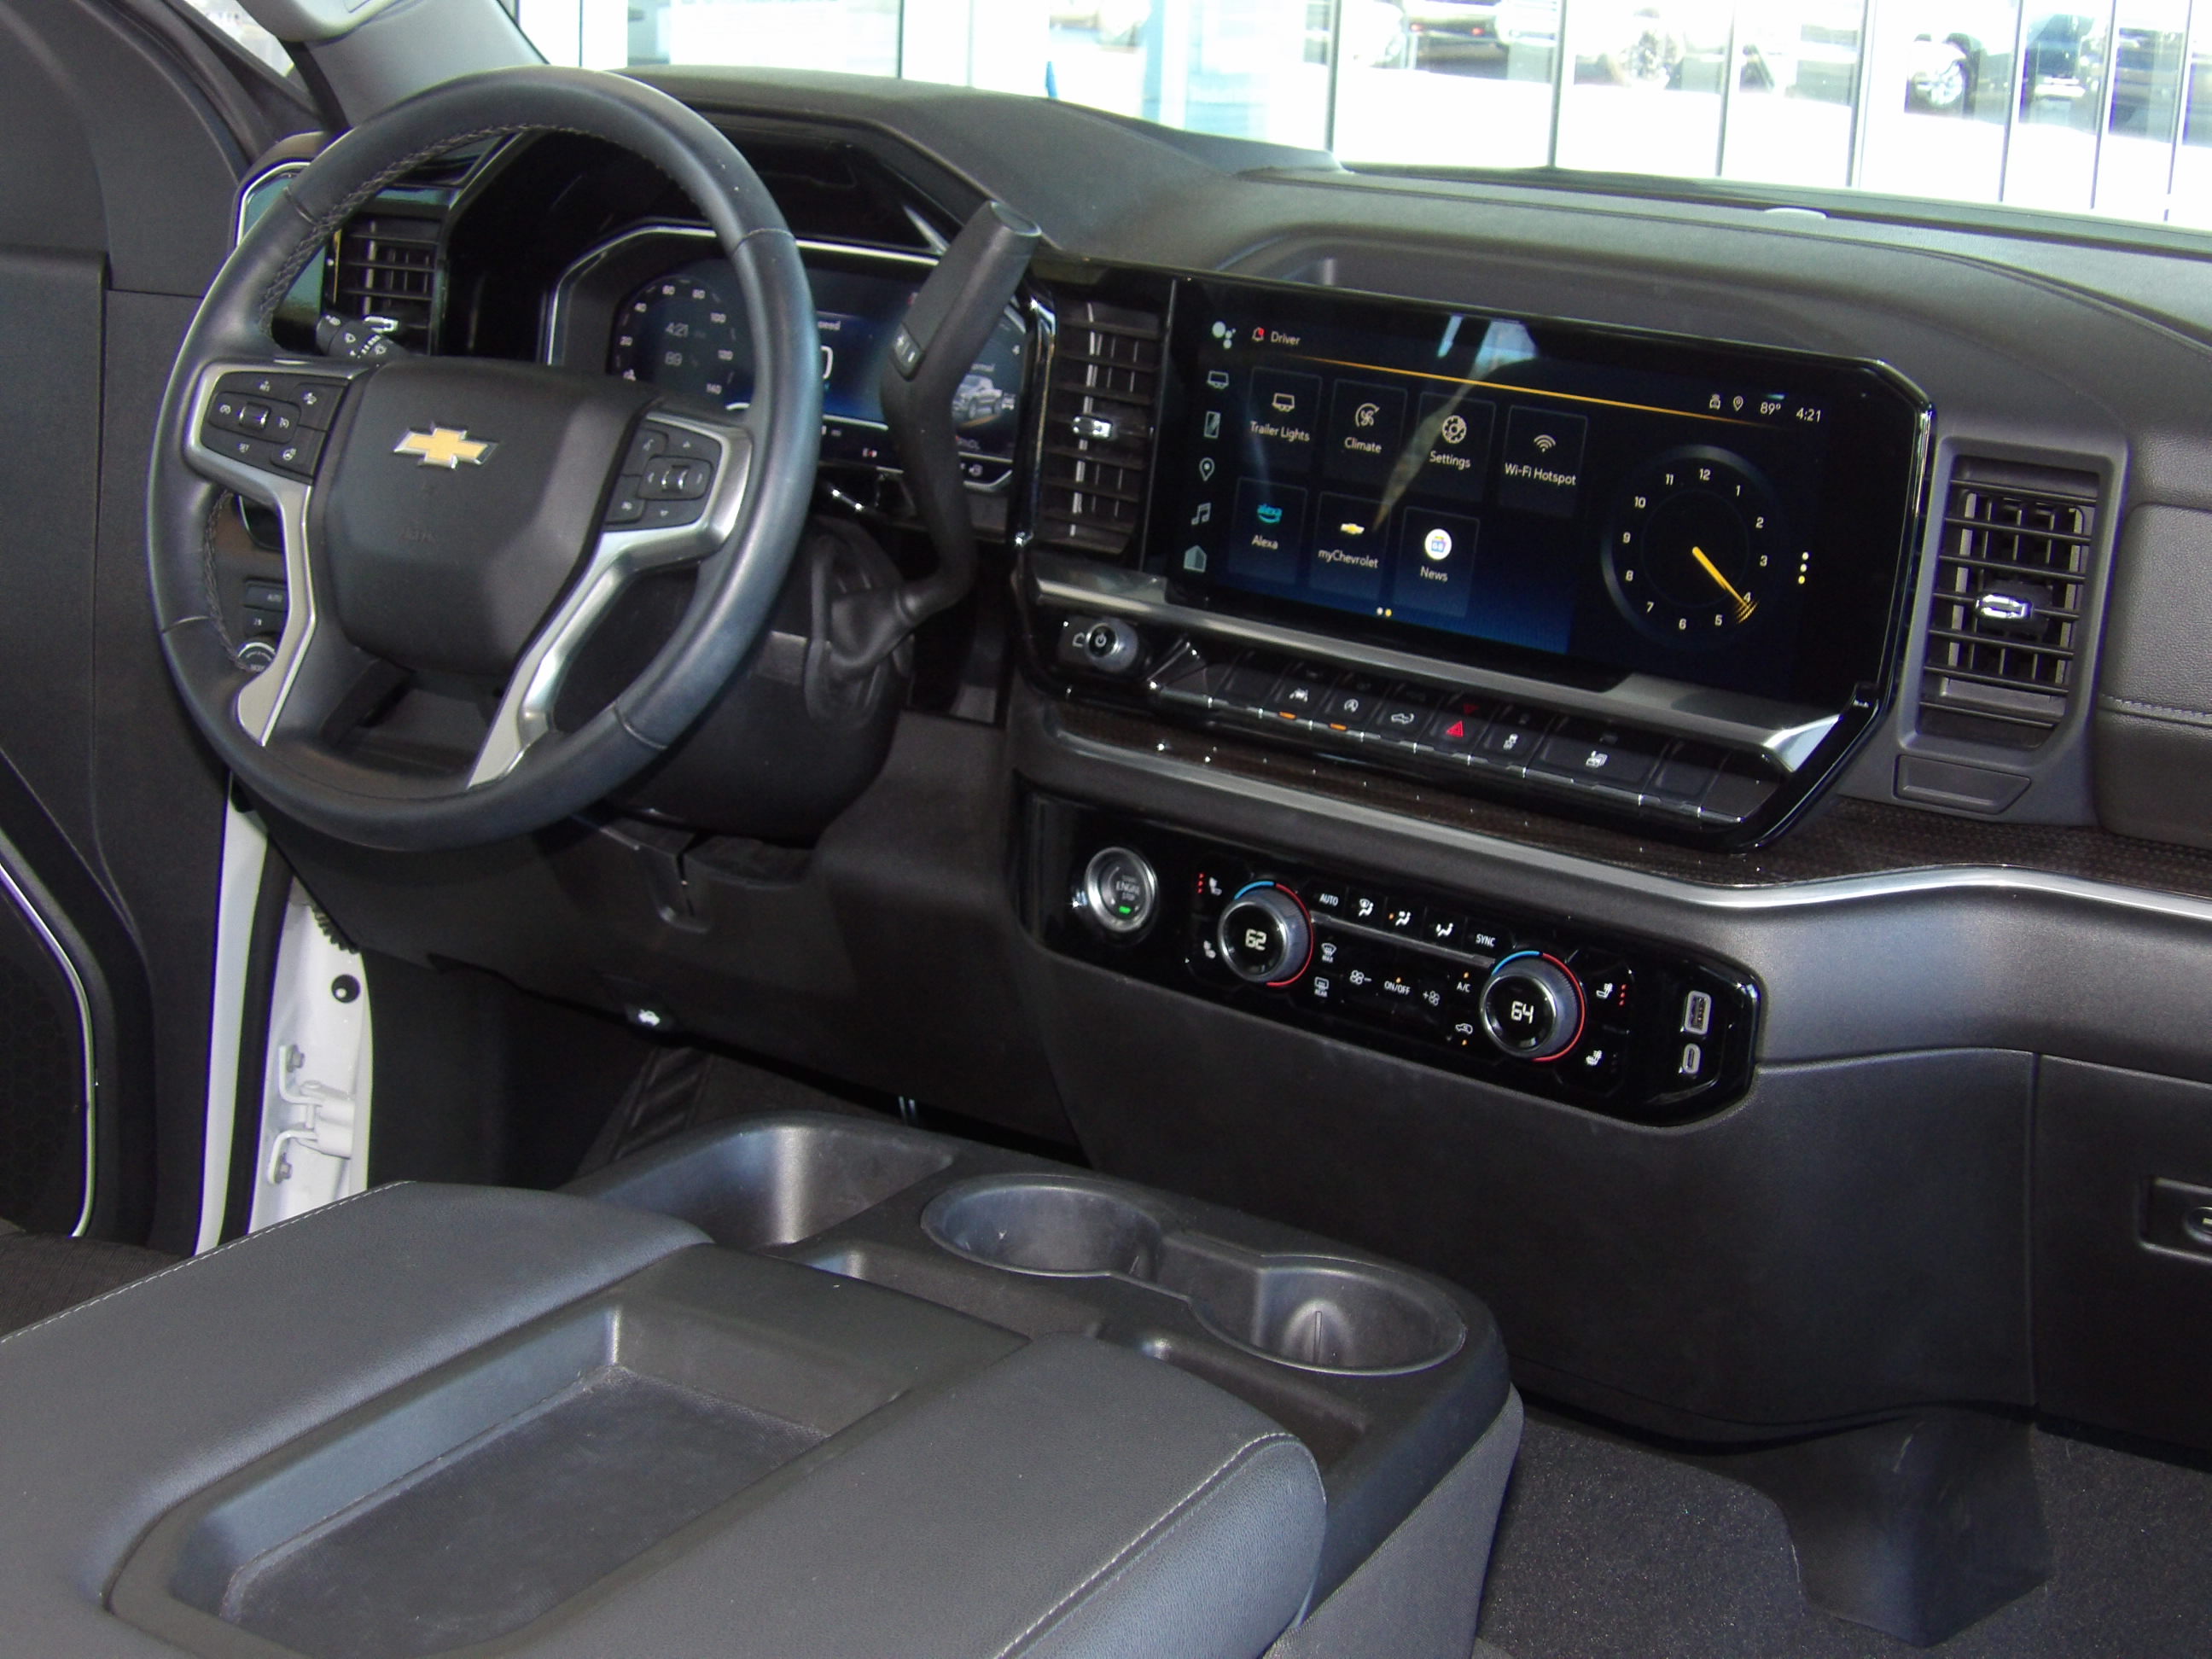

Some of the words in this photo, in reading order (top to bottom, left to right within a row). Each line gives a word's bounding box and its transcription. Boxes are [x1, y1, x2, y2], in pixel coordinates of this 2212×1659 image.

[1270, 331, 1301, 345] Driver
[1796, 408, 1821, 422] 4:21
[1250, 422, 1279, 438] Trailer
[1281, 426, 1310, 442] Lights
[1345, 437, 1382, 454] Climate
[1429, 450, 1471, 469] Settings
[1505, 462, 1531, 479] Wi-Fi
[1534, 469, 1576, 486] Hotspot
[1665, 474, 1674, 486] 11
[1699, 468, 1711, 481] 12
[1735, 485, 1741, 497] 1
[1634, 496, 1646, 509] 10
[1755, 517, 1764, 528] 2
[1252, 534, 1278, 550] Alexa
[1622, 532, 1631, 544] 9
[1318, 548, 1379, 568] myChevrolet
[1760, 555, 1768, 568] 3
[1420, 566, 1448, 582] News
[1625, 570, 1633, 582] 8
[1646, 602, 1655, 614] 7
[1679, 619, 1687, 630] 6
[1714, 614, 1723, 626] 5
[1319, 894, 1338, 906] AUTO
[1244, 928, 1267, 951] 62
[1476, 933, 1496, 947] SYNC
[1384, 980, 1411, 996] ON/OFF
[1457, 981, 1470, 993] A/C
[1511, 1001, 1534, 1024] 64
